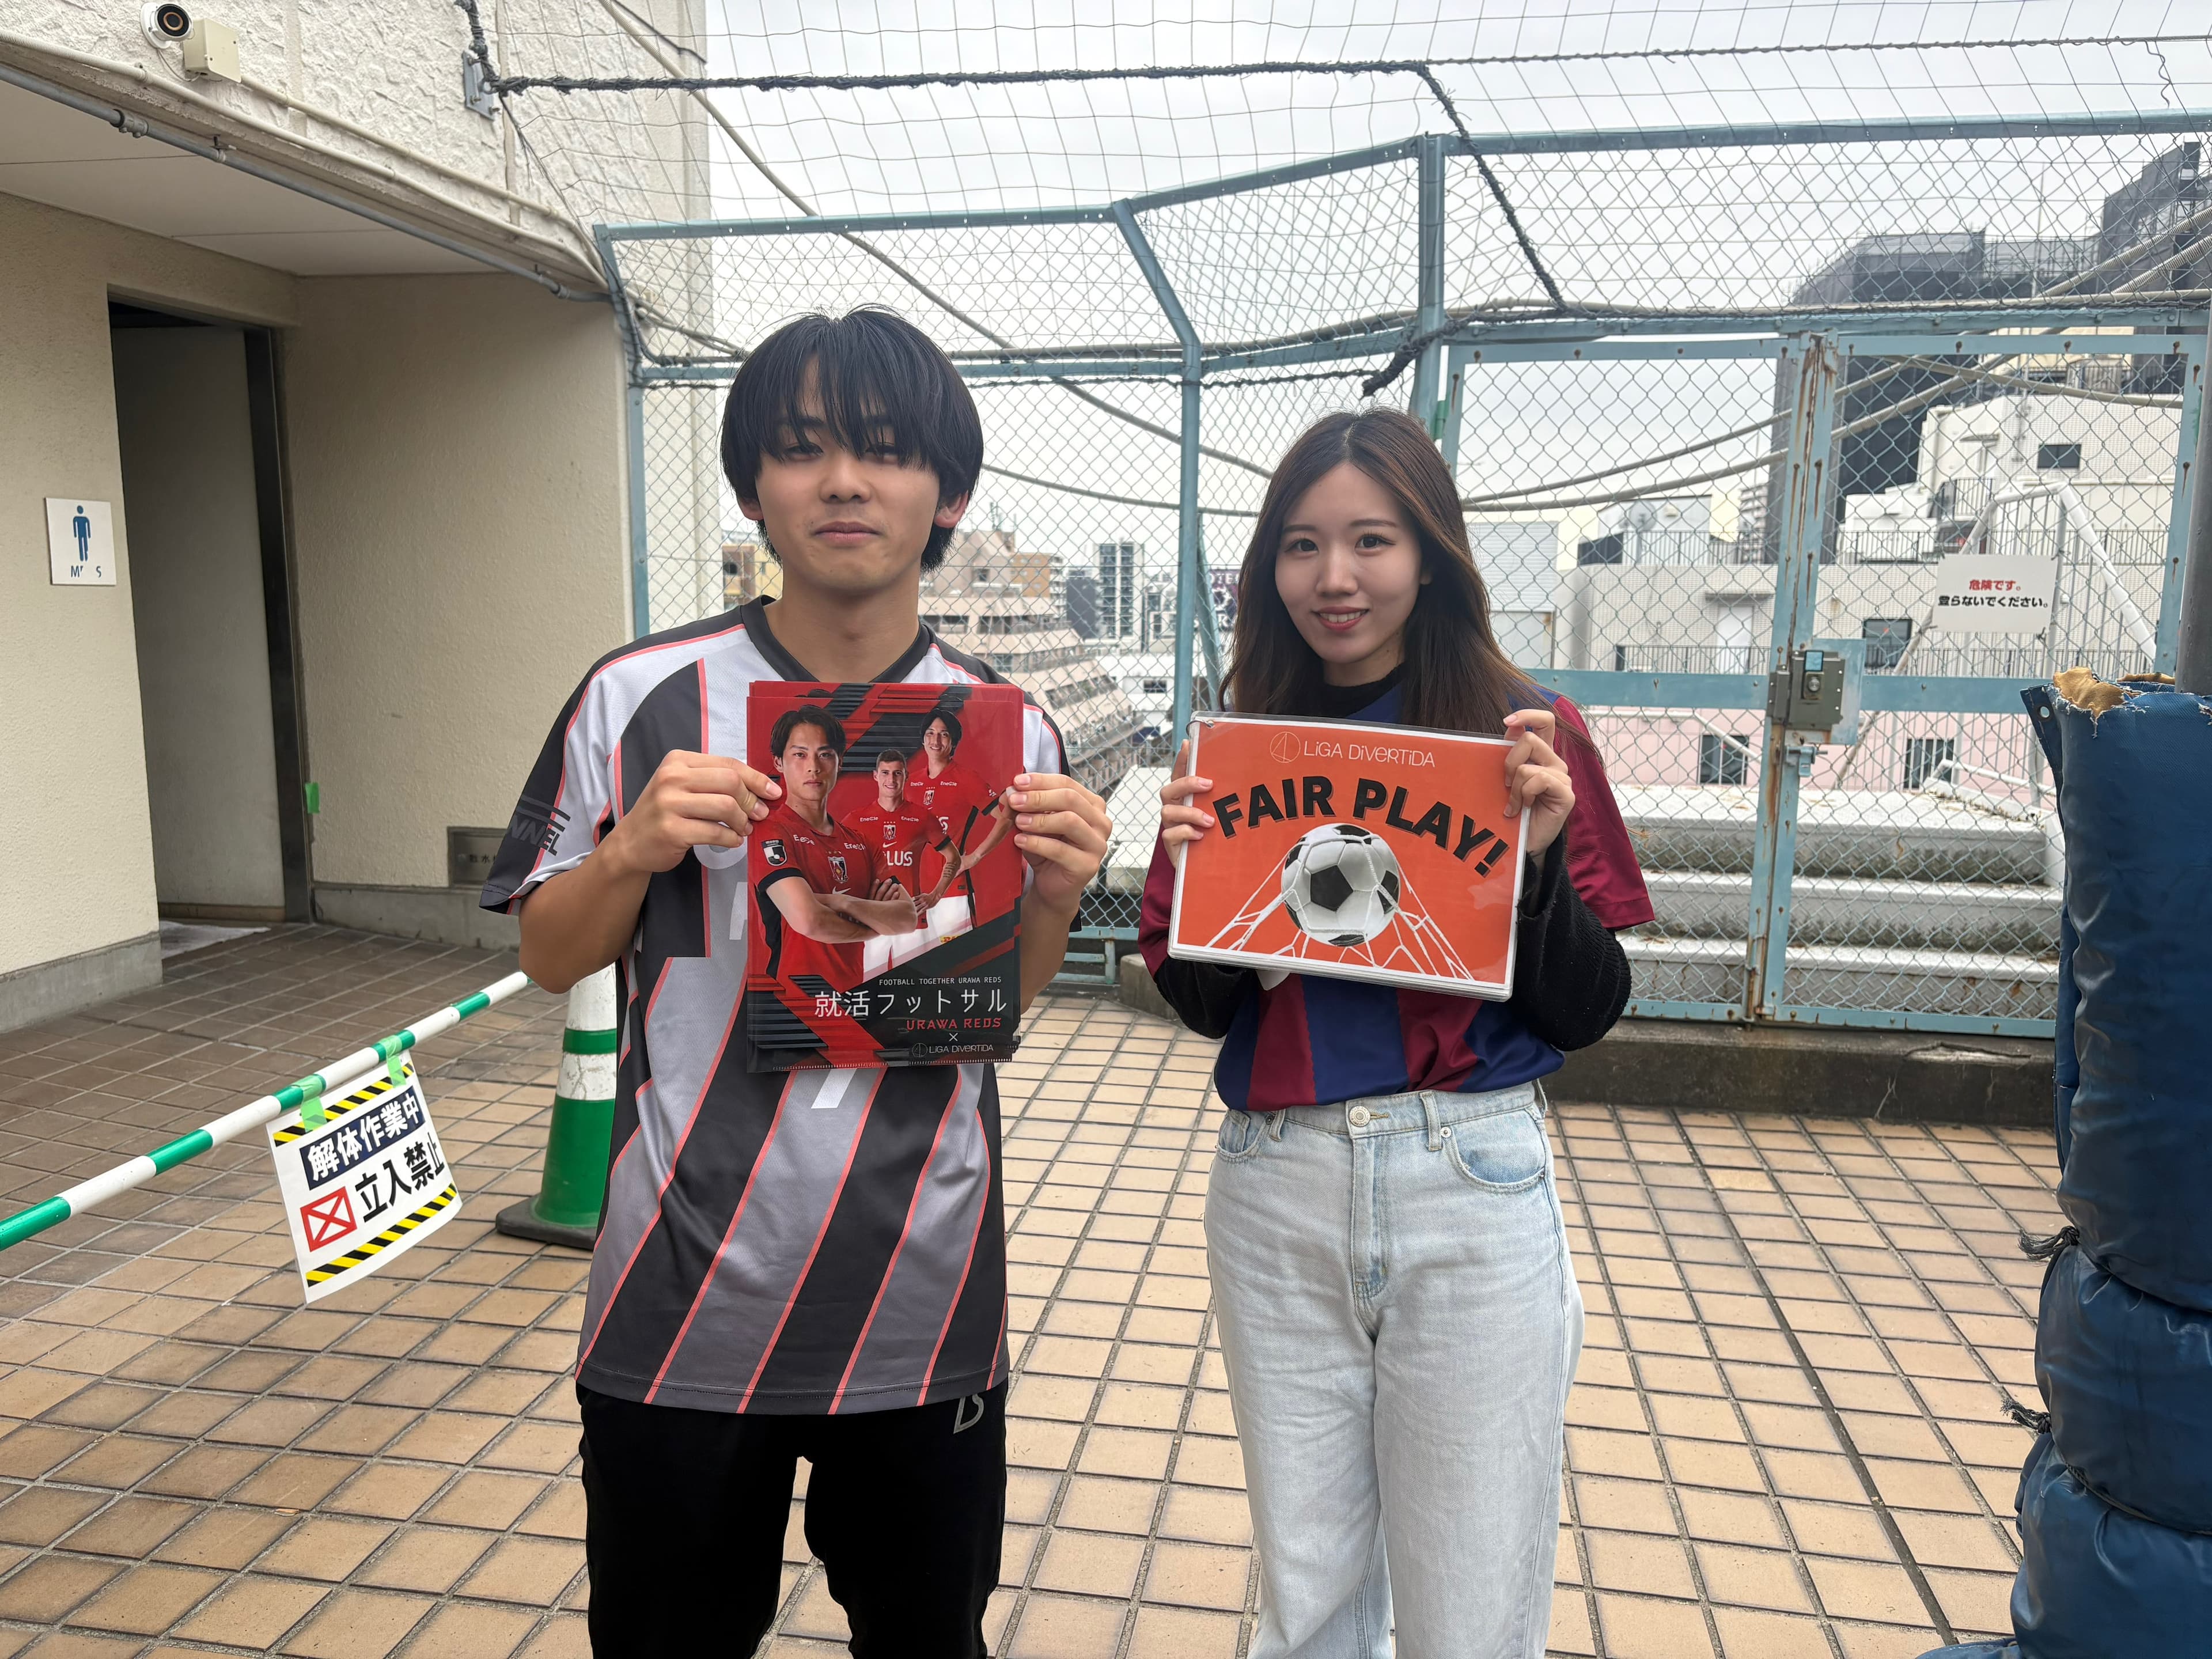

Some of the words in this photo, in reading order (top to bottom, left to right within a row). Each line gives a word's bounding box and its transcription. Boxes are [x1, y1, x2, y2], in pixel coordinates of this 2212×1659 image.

[1969, 579, 2021, 591] 危険です。
[1938, 596, 2048, 608] 登らないでください。
[1212, 775, 1335, 839] FAIR
[1353, 778, 1510, 878] PLAY!
[884, 850, 913, 866] LUS
[814, 988, 1007, 1017] 就活フットサル
[906, 1018, 958, 1031] URAWA
[964, 1017, 1002, 1028] REDS
[308, 1093, 420, 1181] 解体作業中
[355, 1131, 445, 1223] 立入禁止
